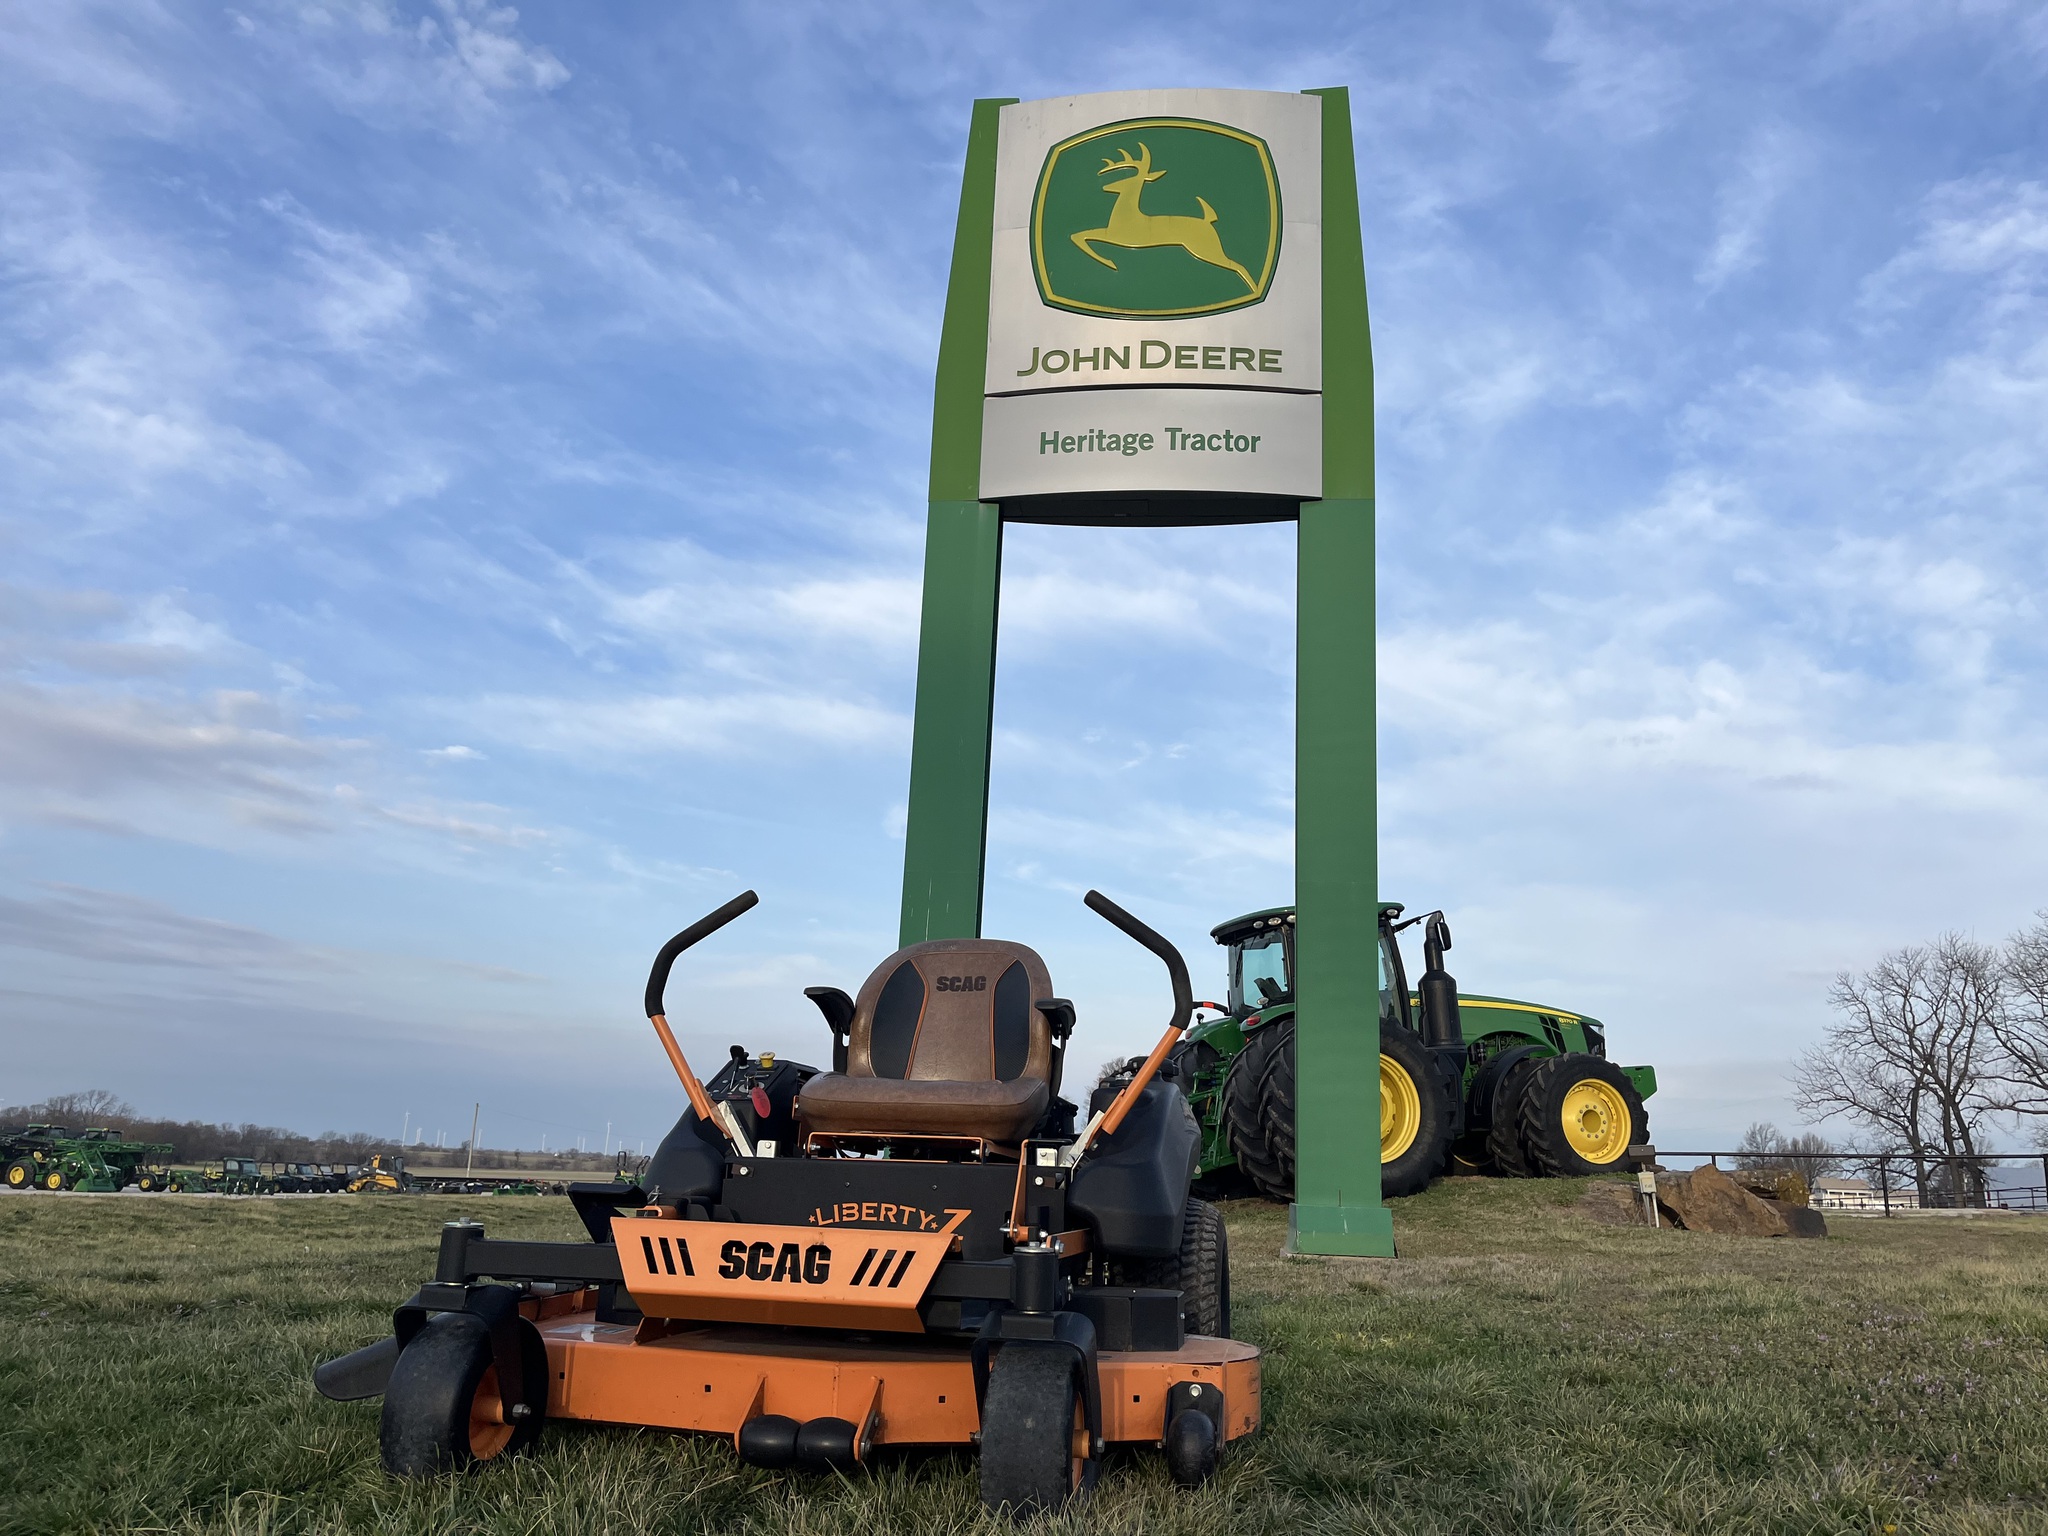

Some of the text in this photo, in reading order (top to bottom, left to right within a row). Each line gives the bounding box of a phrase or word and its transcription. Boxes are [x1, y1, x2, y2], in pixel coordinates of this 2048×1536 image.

[1016, 340, 1283, 377] JOHN DEERE
[1039, 427, 1261, 456] Heritage Tractor
[936, 975, 986, 992] SCAG
[815, 1202, 936, 1231] LIBERTY
[717, 1239, 832, 1285] SCAG
